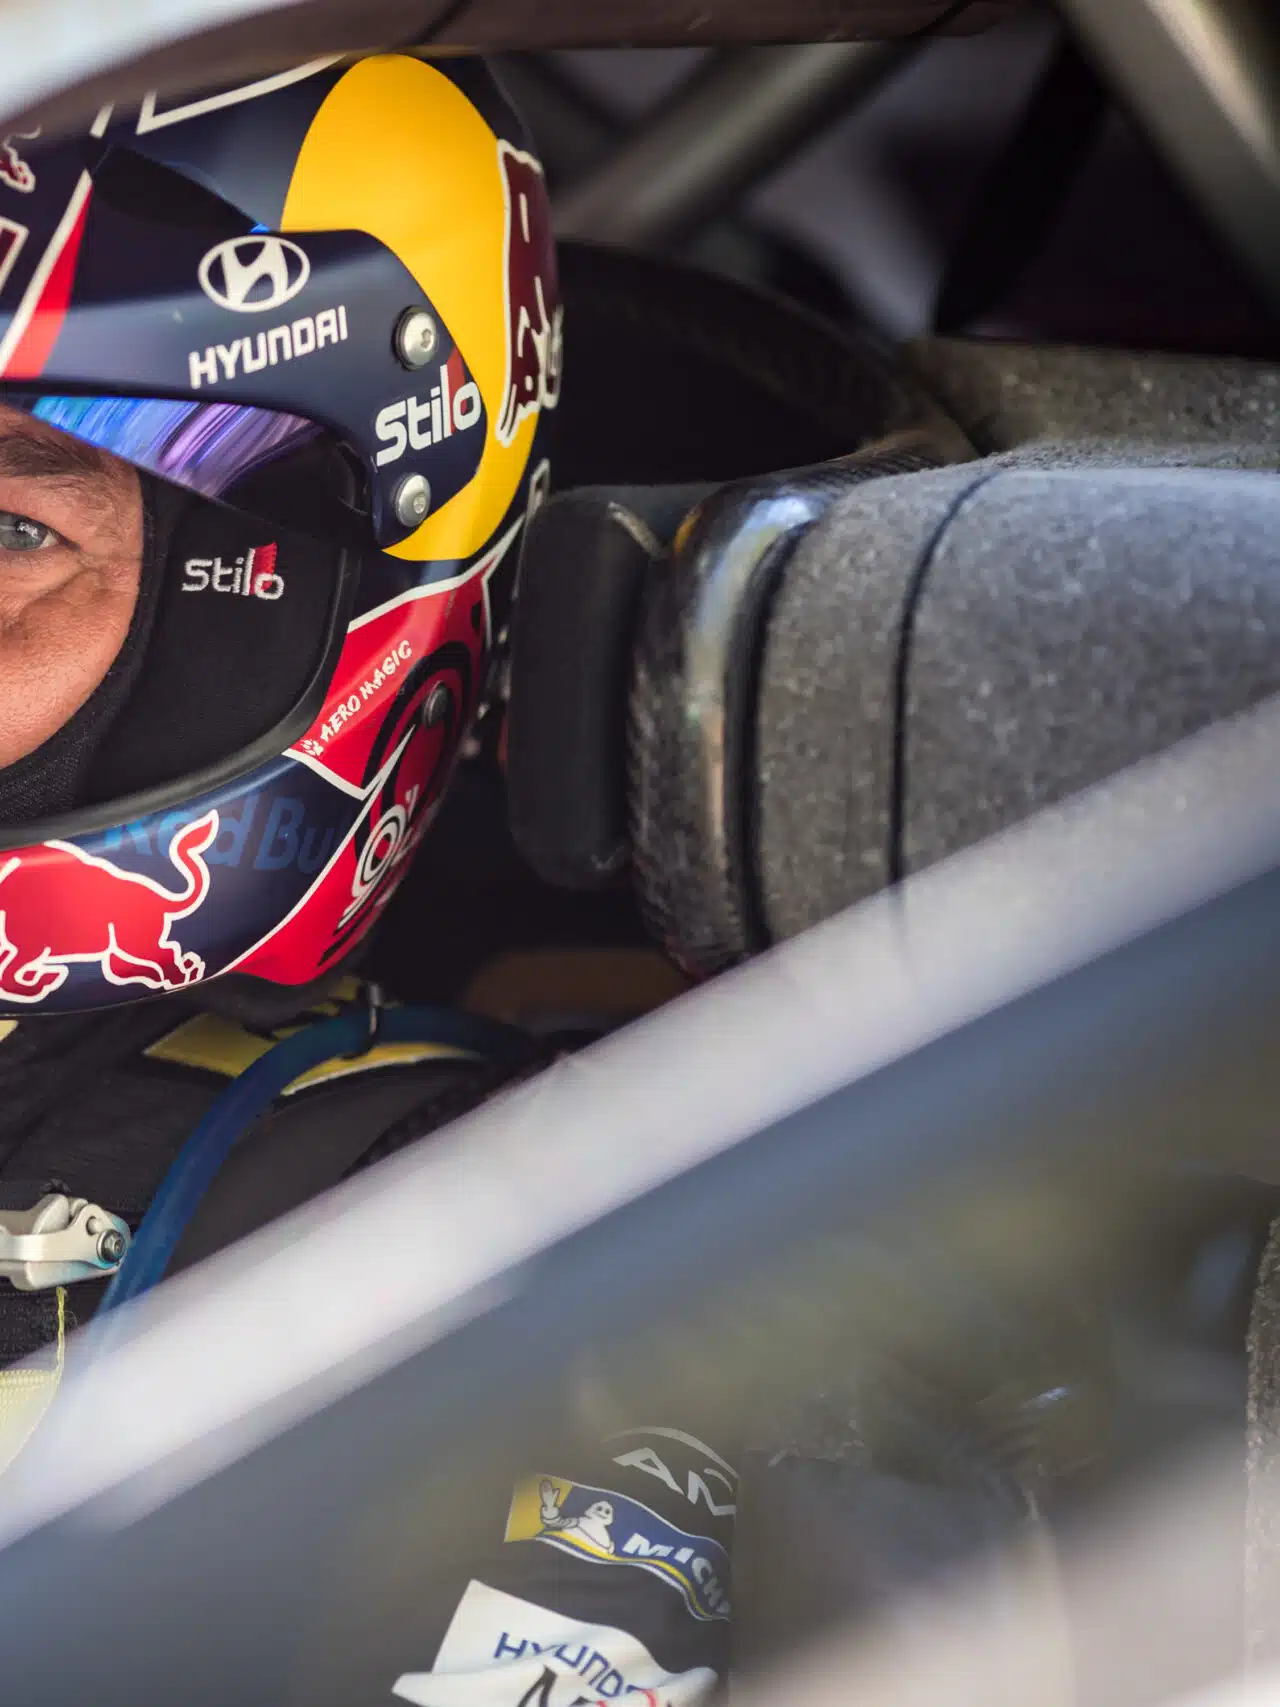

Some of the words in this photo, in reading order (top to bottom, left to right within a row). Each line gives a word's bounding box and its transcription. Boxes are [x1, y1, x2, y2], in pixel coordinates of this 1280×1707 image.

[188, 305, 348, 389] HYUNDAI
[375, 362, 481, 467] Stilo
[182, 546, 284, 600] Stilo
[320, 695, 361, 742] AERO
